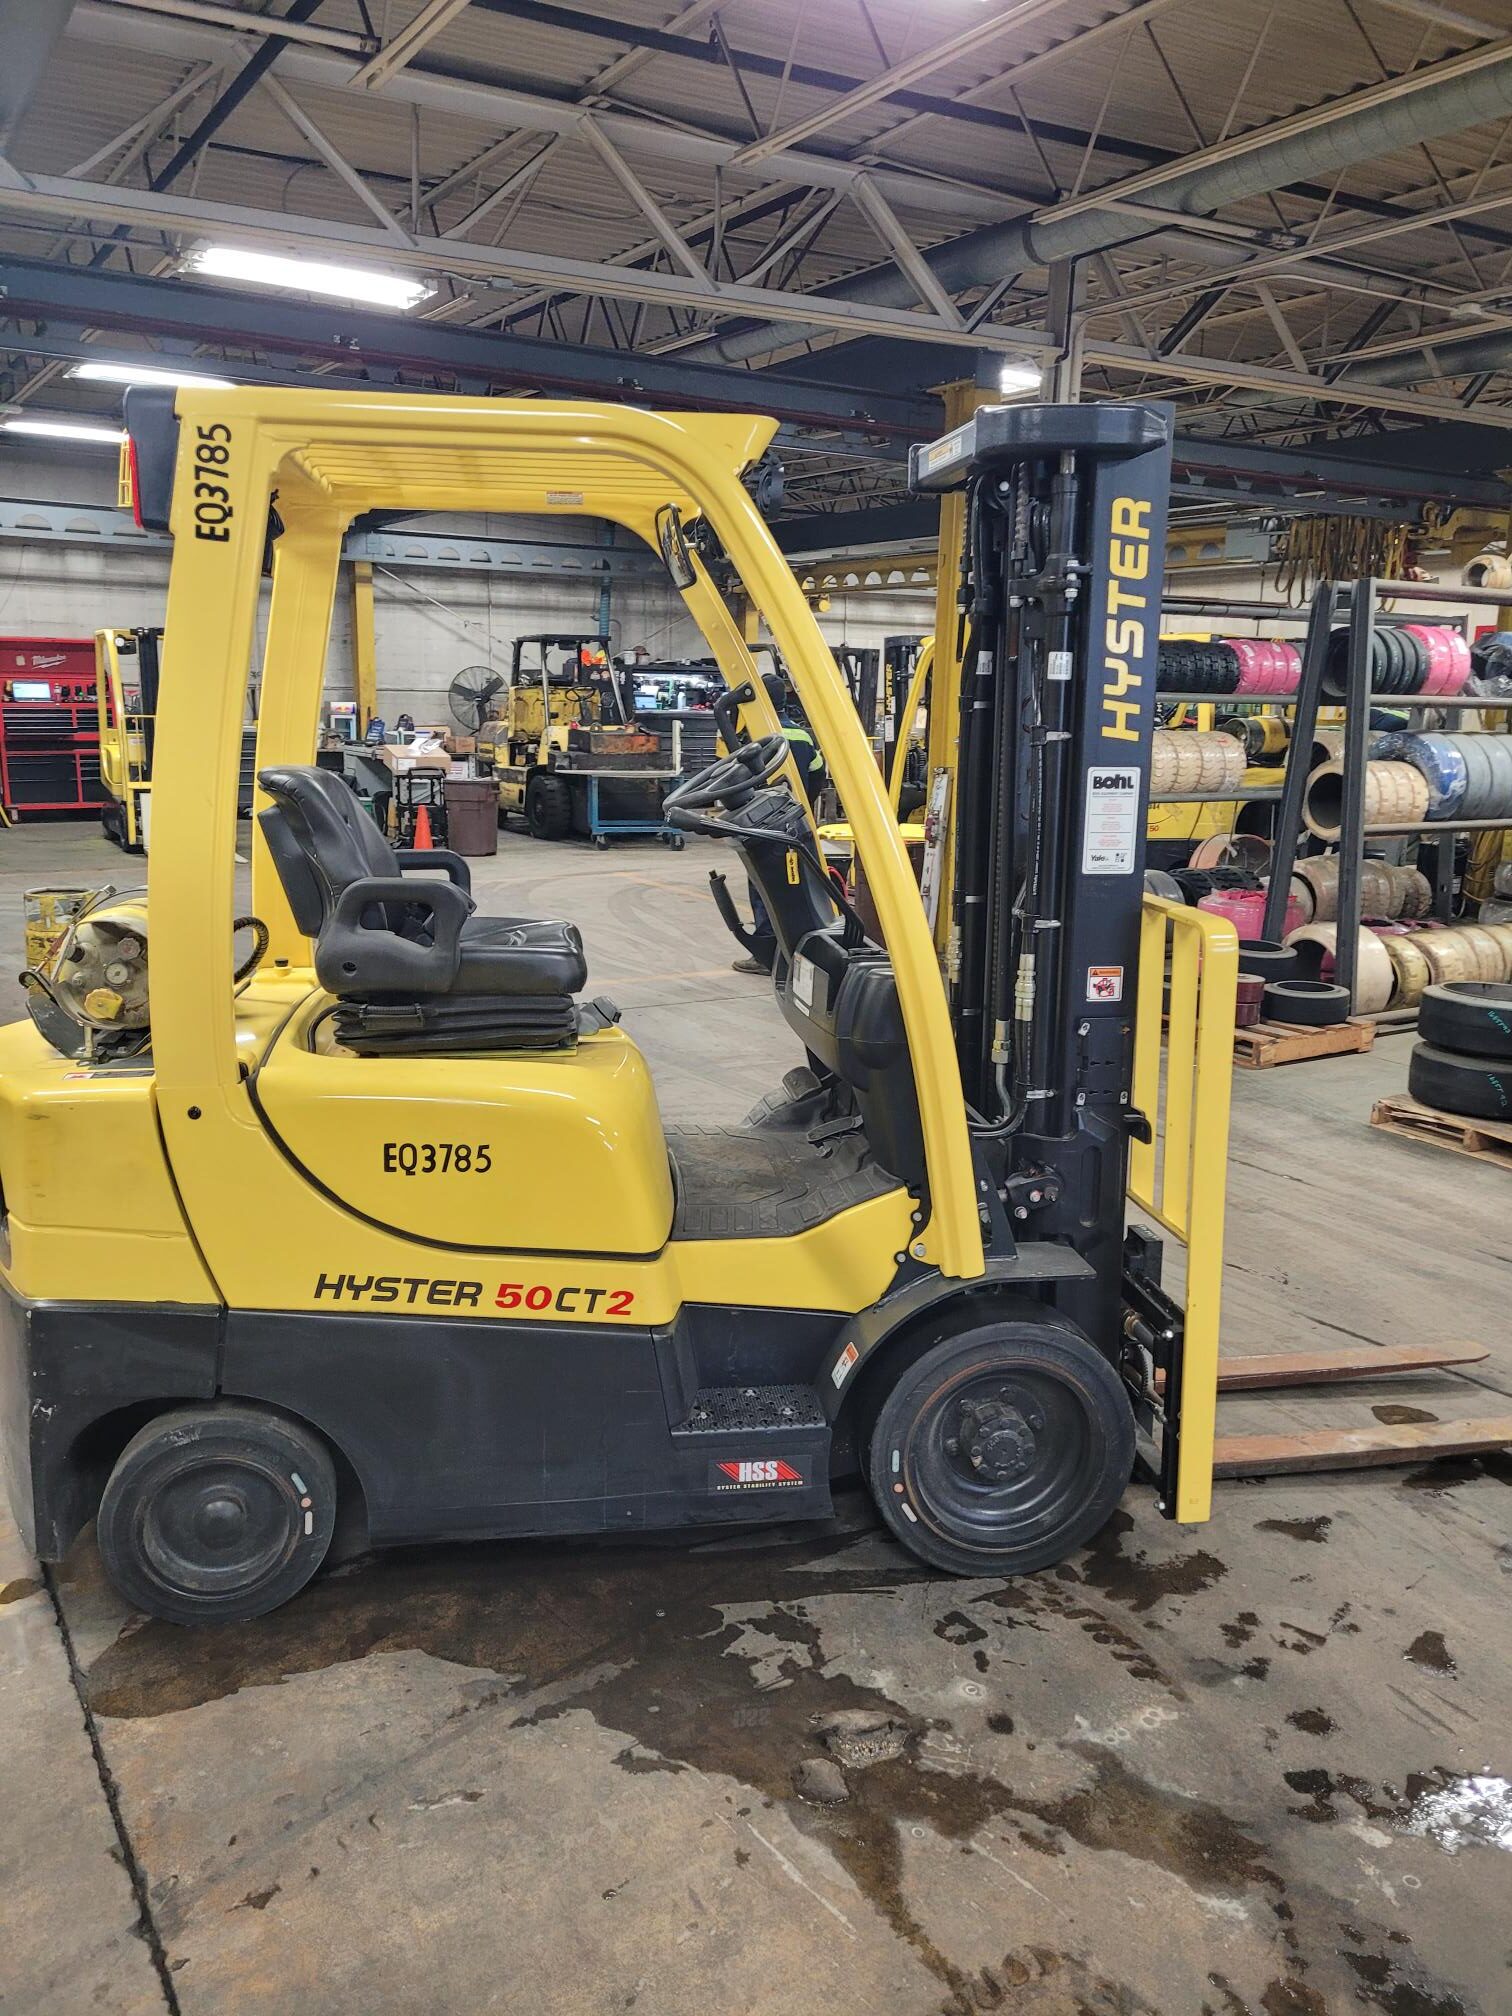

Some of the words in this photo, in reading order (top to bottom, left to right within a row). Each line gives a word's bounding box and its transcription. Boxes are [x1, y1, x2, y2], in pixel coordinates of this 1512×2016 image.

[194, 423, 233, 542] EQ3785
[1101, 497, 1151, 742] HYSTER
[384, 1143, 492, 1176] EQ3785
[314, 1273, 483, 1307] HYSTER
[494, 1283, 635, 1316] 50CT2
[738, 1460, 778, 1482] HSS
